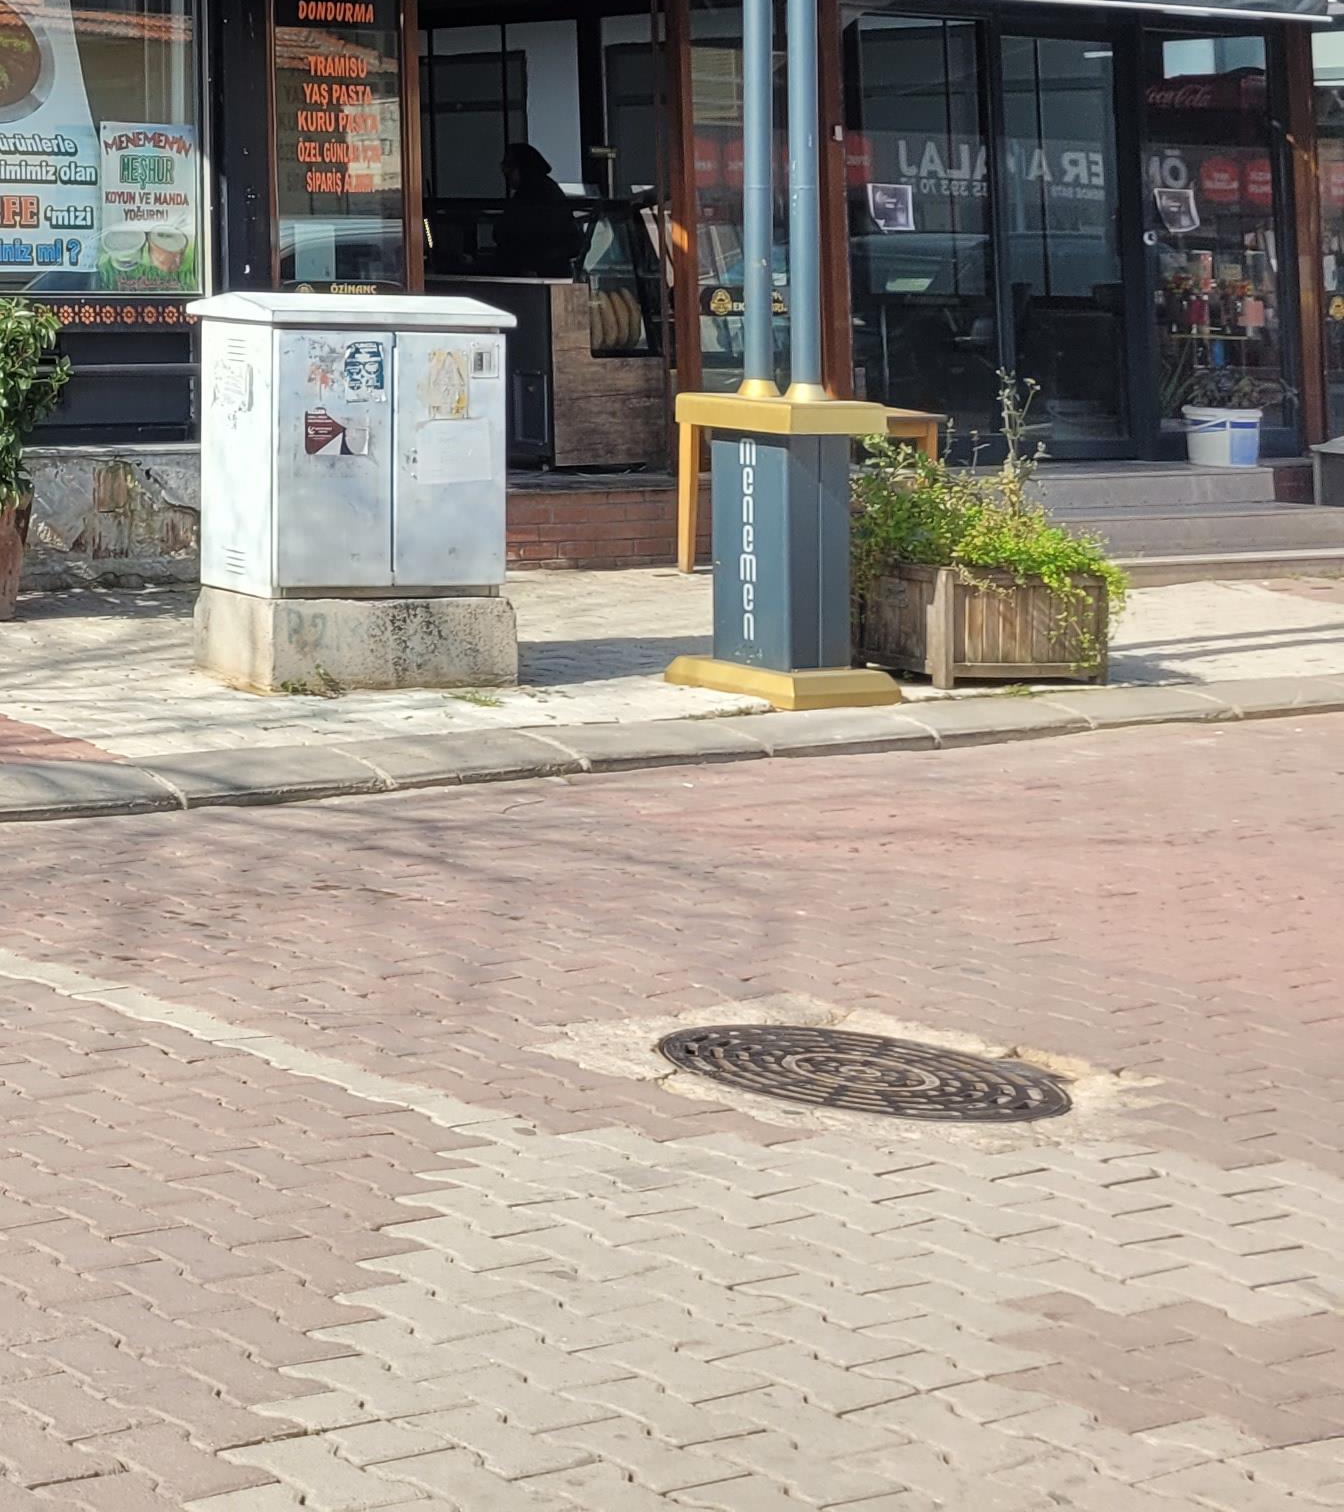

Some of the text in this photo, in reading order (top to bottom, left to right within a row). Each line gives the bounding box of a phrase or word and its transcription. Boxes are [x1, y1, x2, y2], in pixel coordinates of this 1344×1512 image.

[298, 0, 375, 24] DONDURMA
[303, 82, 373, 110] YAŞ PASTA
[297, 110, 335, 133] KURU
[297, 139, 322, 163] ÖZEL
[59, 162, 97, 185] olan
[120, 154, 174, 190] MEŞHUR
[306, 167, 342, 197] SİPARİŞ
[104, 190, 190, 206] KOYUN VE MANDA
[123, 205, 169, 222] YOĞURDU
[66, 239, 81, 266] ?
